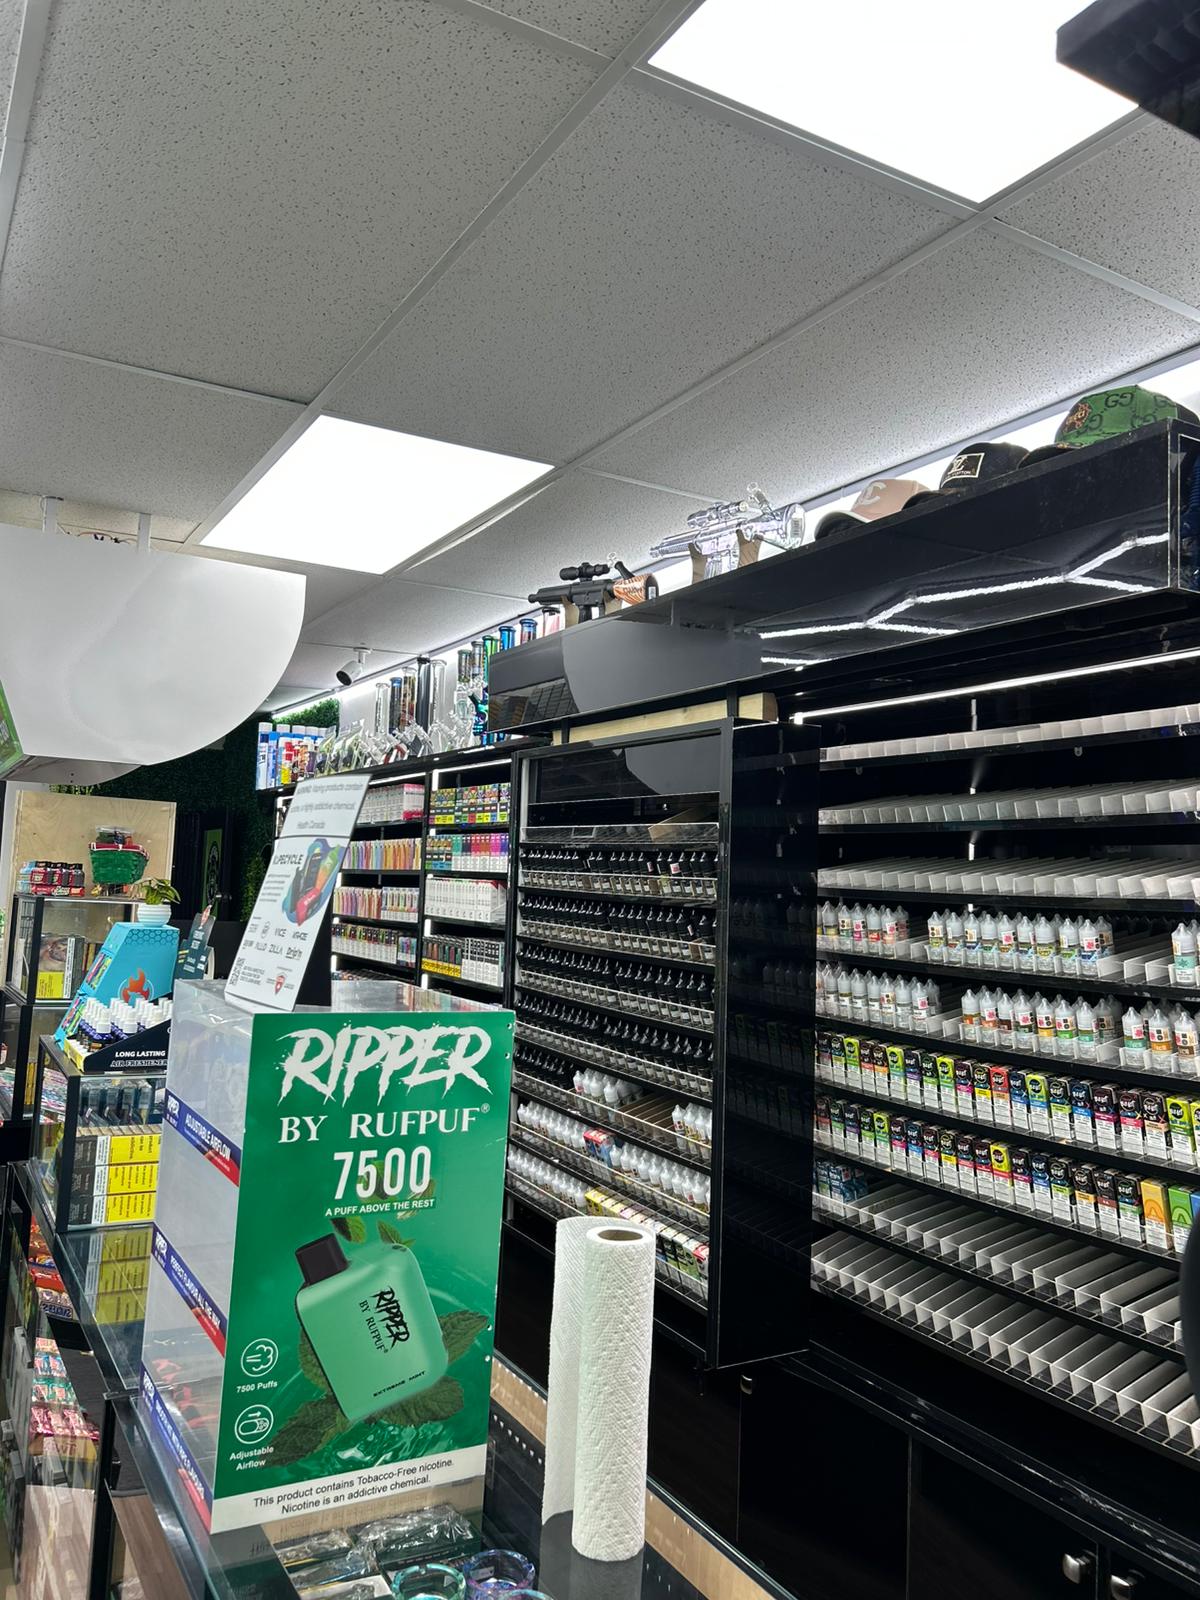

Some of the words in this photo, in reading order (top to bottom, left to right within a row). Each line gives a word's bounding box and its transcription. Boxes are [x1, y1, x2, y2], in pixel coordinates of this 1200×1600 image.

[276, 1020, 493, 1108] RIPPER
[278, 1115, 328, 1144] BY
[333, 1145, 432, 1200] 7500
[325, 1208, 333, 1216] A
[334, 1205, 358, 1216] PUFF
[359, 1203, 391, 1213] ABOVE
[392, 1201, 411, 1210] THE
[411, 1199, 435, 1209] REST
[359, 1300, 371, 1313] BY
[370, 1286, 410, 1349] RIPPER
[236, 1383, 255, 1393] 7500
[257, 1380, 278, 1391] Puffs
[229, 1445, 274, 1461] Adjustable
[236, 1458, 266, 1471] Airflow
[254, 1496, 274, 1508] This
[277, 1487, 313, 1503] product
[315, 1478, 355, 1497] contains
[357, 1467, 417, 1486] Tobacco-Free
[419, 1458, 455, 1472] nicotine.
[281, 1498, 320, 1514] Nicotine
[322, 1496, 332, 1505] is
[333, 1494, 345, 1503] an
[347, 1483, 388, 1500] addictive
[390, 1474, 431, 1491] chemical.
